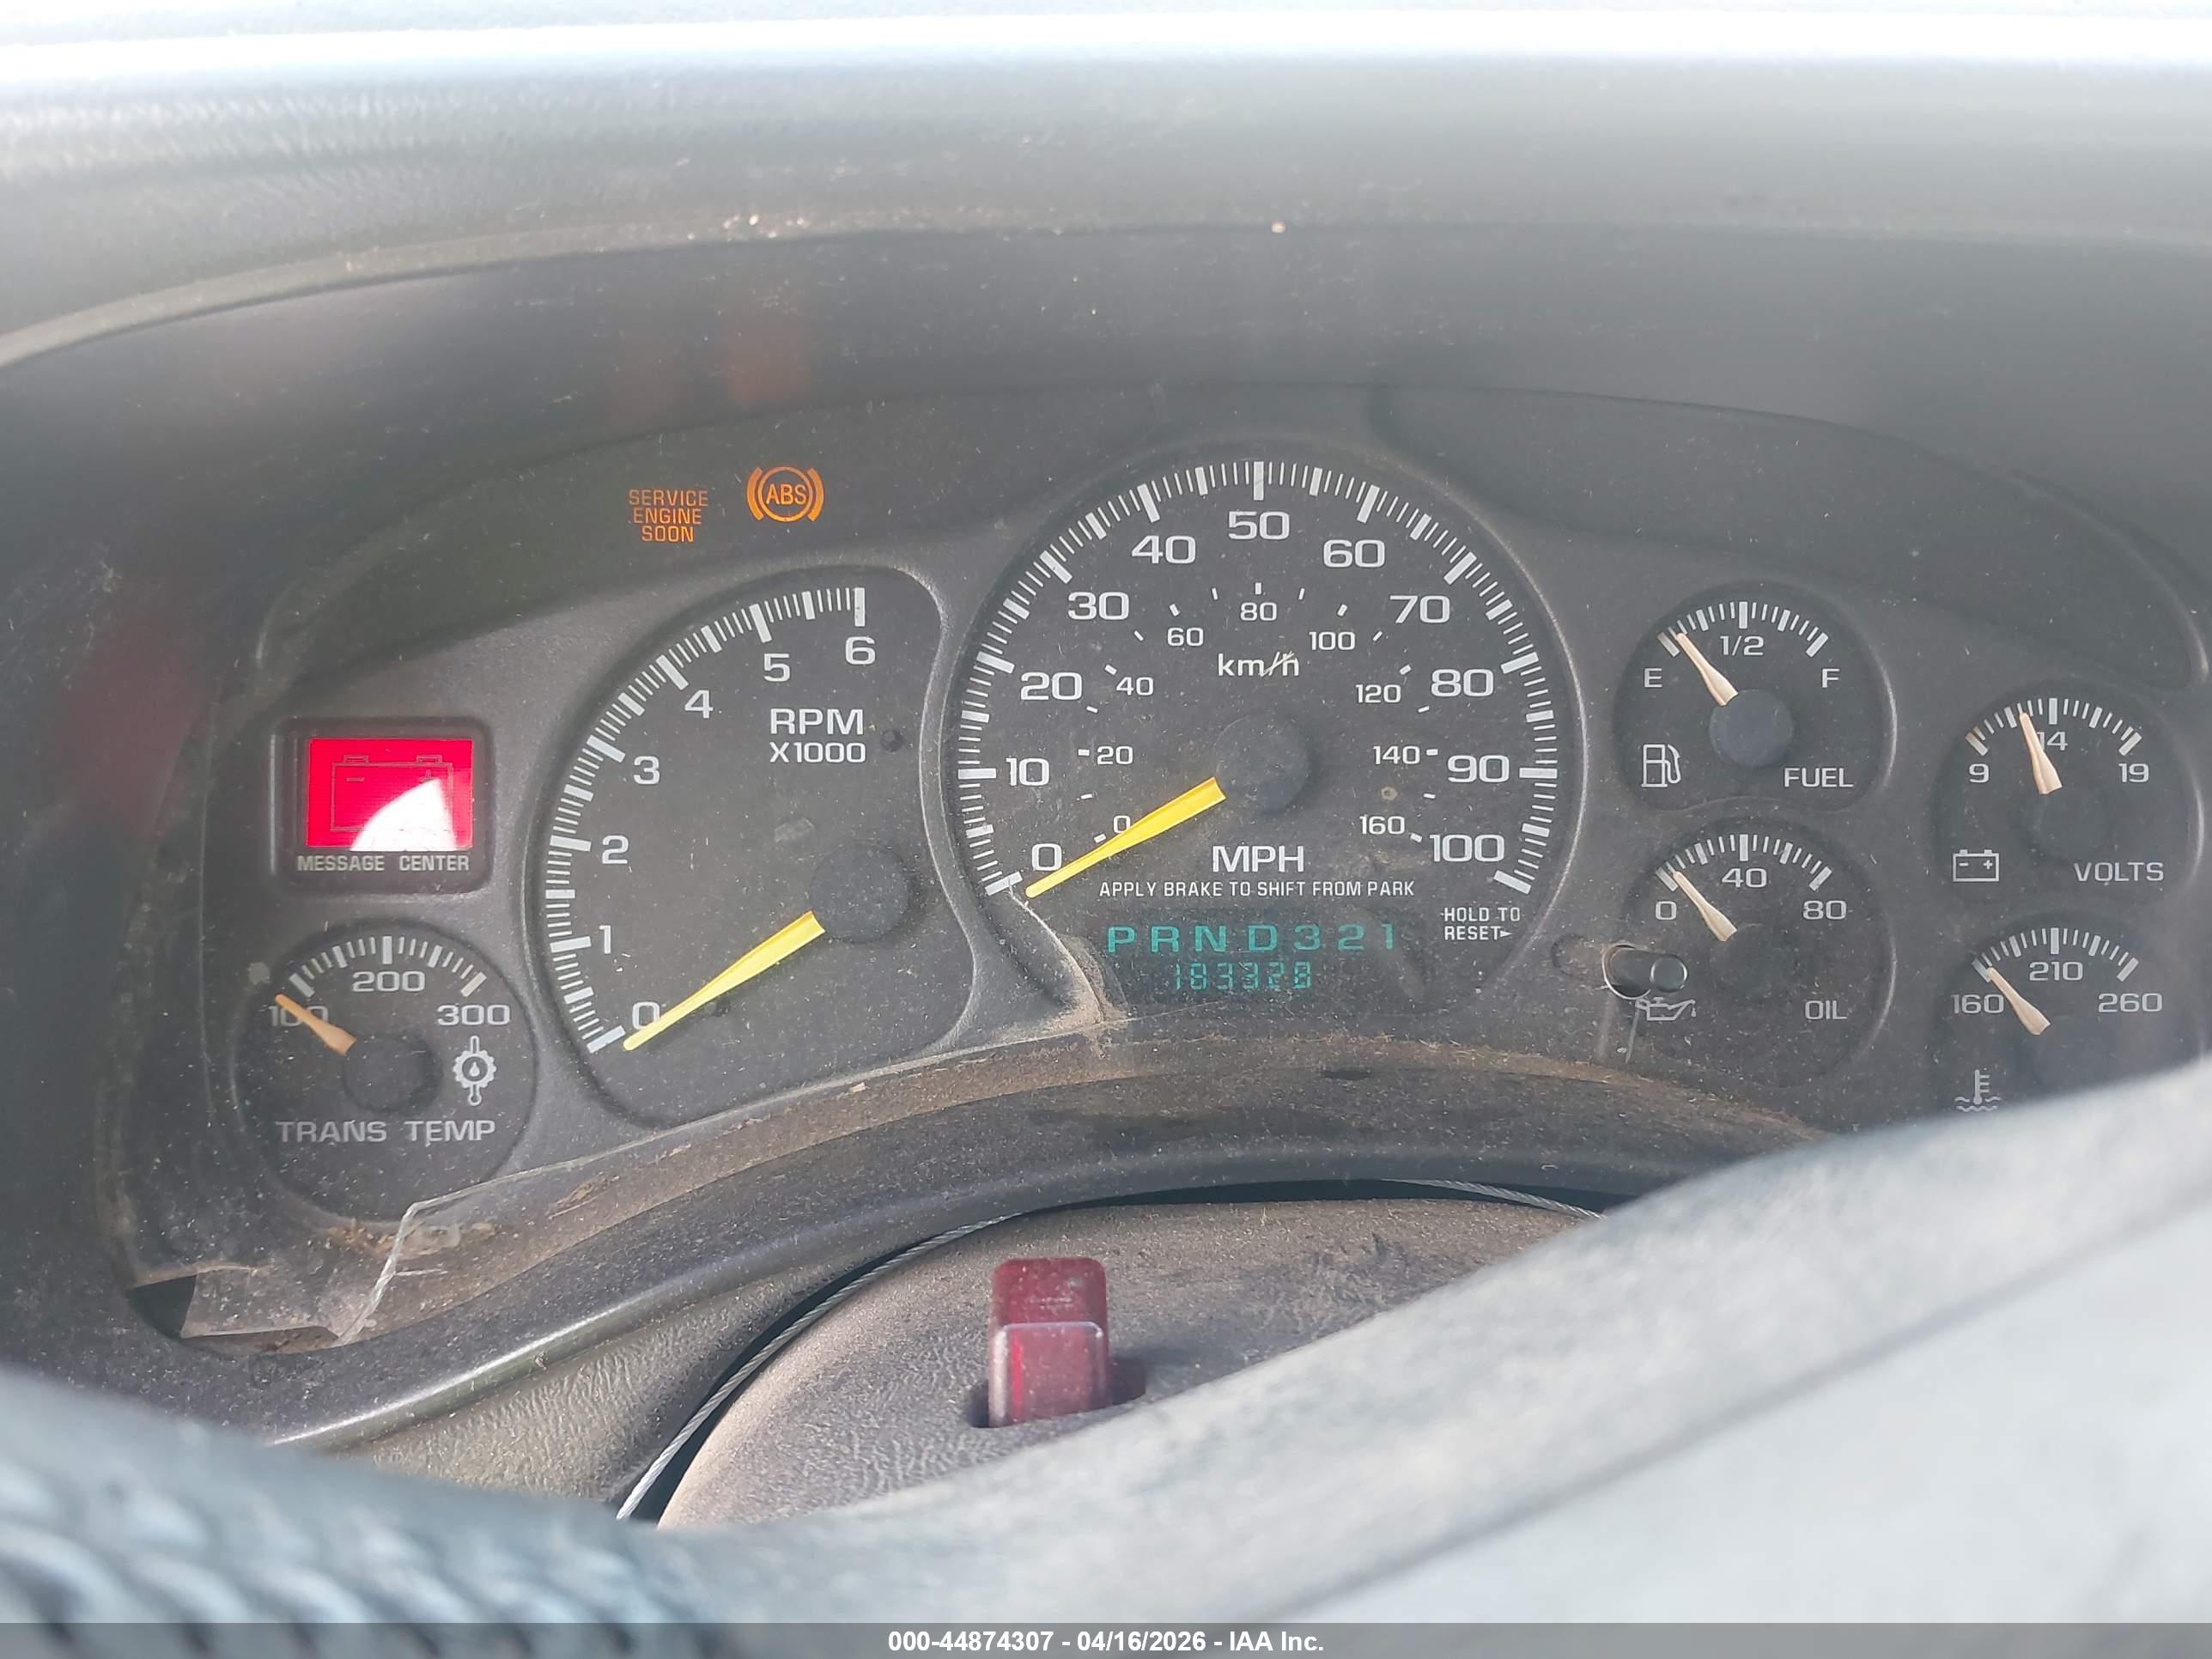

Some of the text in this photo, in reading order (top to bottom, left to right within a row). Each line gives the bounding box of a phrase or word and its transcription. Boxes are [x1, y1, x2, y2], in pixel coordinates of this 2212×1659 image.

[629, 489, 708, 507] SERVICE
[766, 483, 807, 505] ABS
[634, 508, 702, 525] ENGINE
[1229, 512, 1289, 541] 50
[641, 526, 694, 543] SOON
[1132, 536, 1196, 564] 40
[1323, 539, 1385, 568] 60
[1067, 592, 1129, 620] 30
[1241, 603, 1278, 623] 80
[1390, 595, 1450, 624] 70
[1167, 627, 1204, 647] 60
[1310, 631, 1356, 651] 100
[1720, 635, 1765, 657] 1/2
[845, 635, 876, 665] 6
[763, 653, 791, 683] 5
[1218, 652, 1300, 677] km/h
[1020, 672, 1083, 701] 20
[1116, 677, 1154, 696] 40
[1431, 669, 1494, 697] 80
[1644, 668, 1662, 688] E
[1822, 669, 1840, 688] F
[1356, 684, 1401, 704] 120
[684, 690, 714, 719] 4
[770, 709, 864, 735] RPM
[2036, 732, 2068, 750] 14
[769, 743, 866, 763] X1000
[1097, 745, 1133, 765] 20
[1374, 745, 1420, 764] 140
[634, 756, 660, 785] 3
[1006, 758, 1049, 787] 10
[1447, 756, 1510, 783] 90
[1784, 768, 1853, 787] FUEL
[1969, 763, 1990, 783] 9
[2118, 763, 2149, 782] 19
[1113, 815, 1131, 834] 0
[1360, 815, 1406, 835] 160
[602, 836, 629, 864] 2
[1031, 843, 1062, 872] 0
[1212, 845, 1304, 872] MPH
[1432, 835, 1504, 862] 100
[297, 856, 470, 872] MESSAGE CENTER
[2075, 861, 2164, 882] VOLTS
[1722, 868, 1768, 889] 40
[1099, 882, 1415, 897] APPLY BRAKE TO SHIFT FROM PARK
[1444, 907, 1521, 921] HOLD TO
[1655, 901, 1676, 920] 0
[1803, 901, 1846, 920] 80
[599, 926, 611, 954] 1
[1108, 923, 1395, 953] P R N D 3 2 1
[1444, 926, 1501, 940] RESET
[352, 971, 425, 991] 200
[1175, 961, 1313, 990] 183328
[2029, 961, 2082, 981] 210
[1805, 1000, 1847, 1020] OIL
[1953, 994, 2004, 1014] 160
[2098, 994, 2162, 1012] 260
[437, 1005, 510, 1024] 300
[632, 1001, 660, 1030] 0
[276, 1121, 495, 1144] TRANS TEMP
